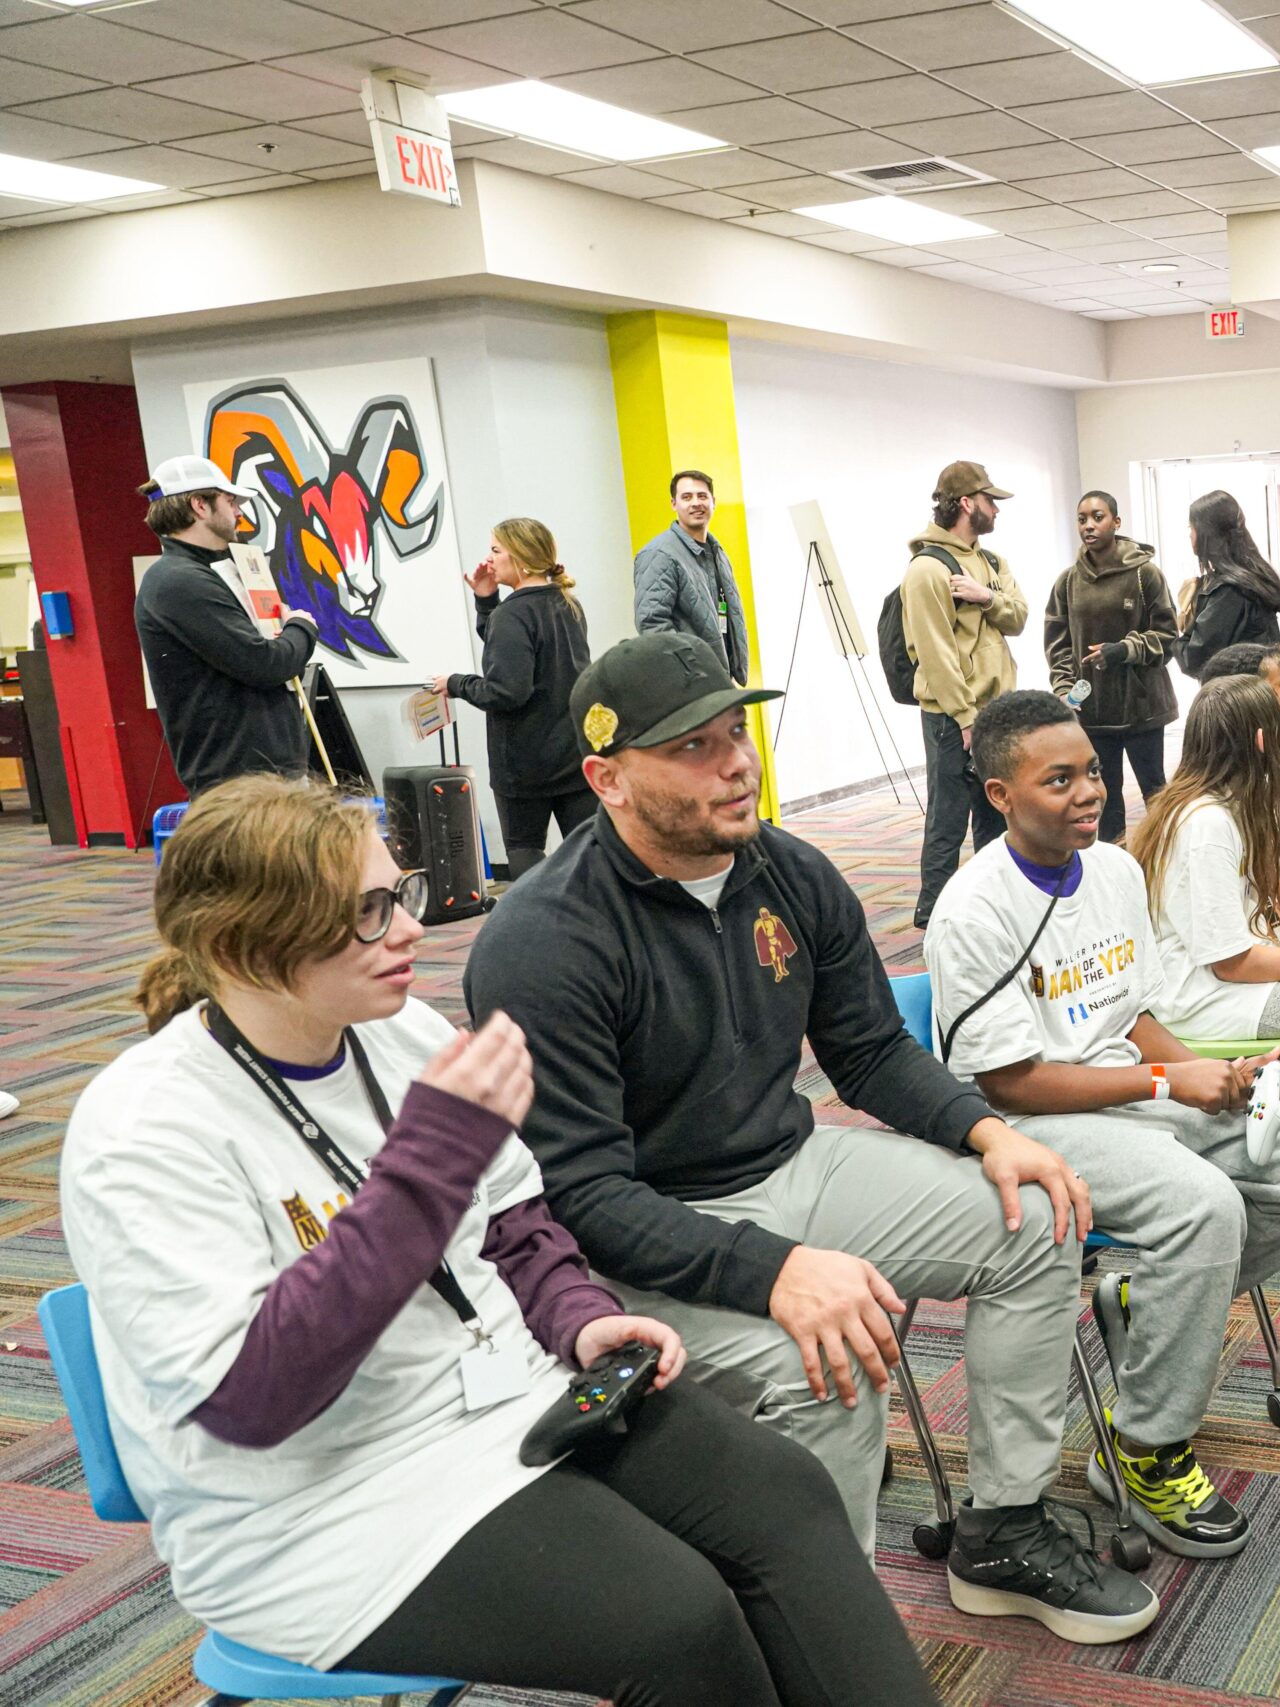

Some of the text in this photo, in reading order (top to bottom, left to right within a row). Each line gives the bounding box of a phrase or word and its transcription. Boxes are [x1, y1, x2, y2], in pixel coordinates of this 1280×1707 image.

[396, 135, 446, 193] EXIT
[1212, 311, 1238, 336] EXIT
[1083, 957, 1095, 971] OF
[1083, 969, 1105, 985] THE
